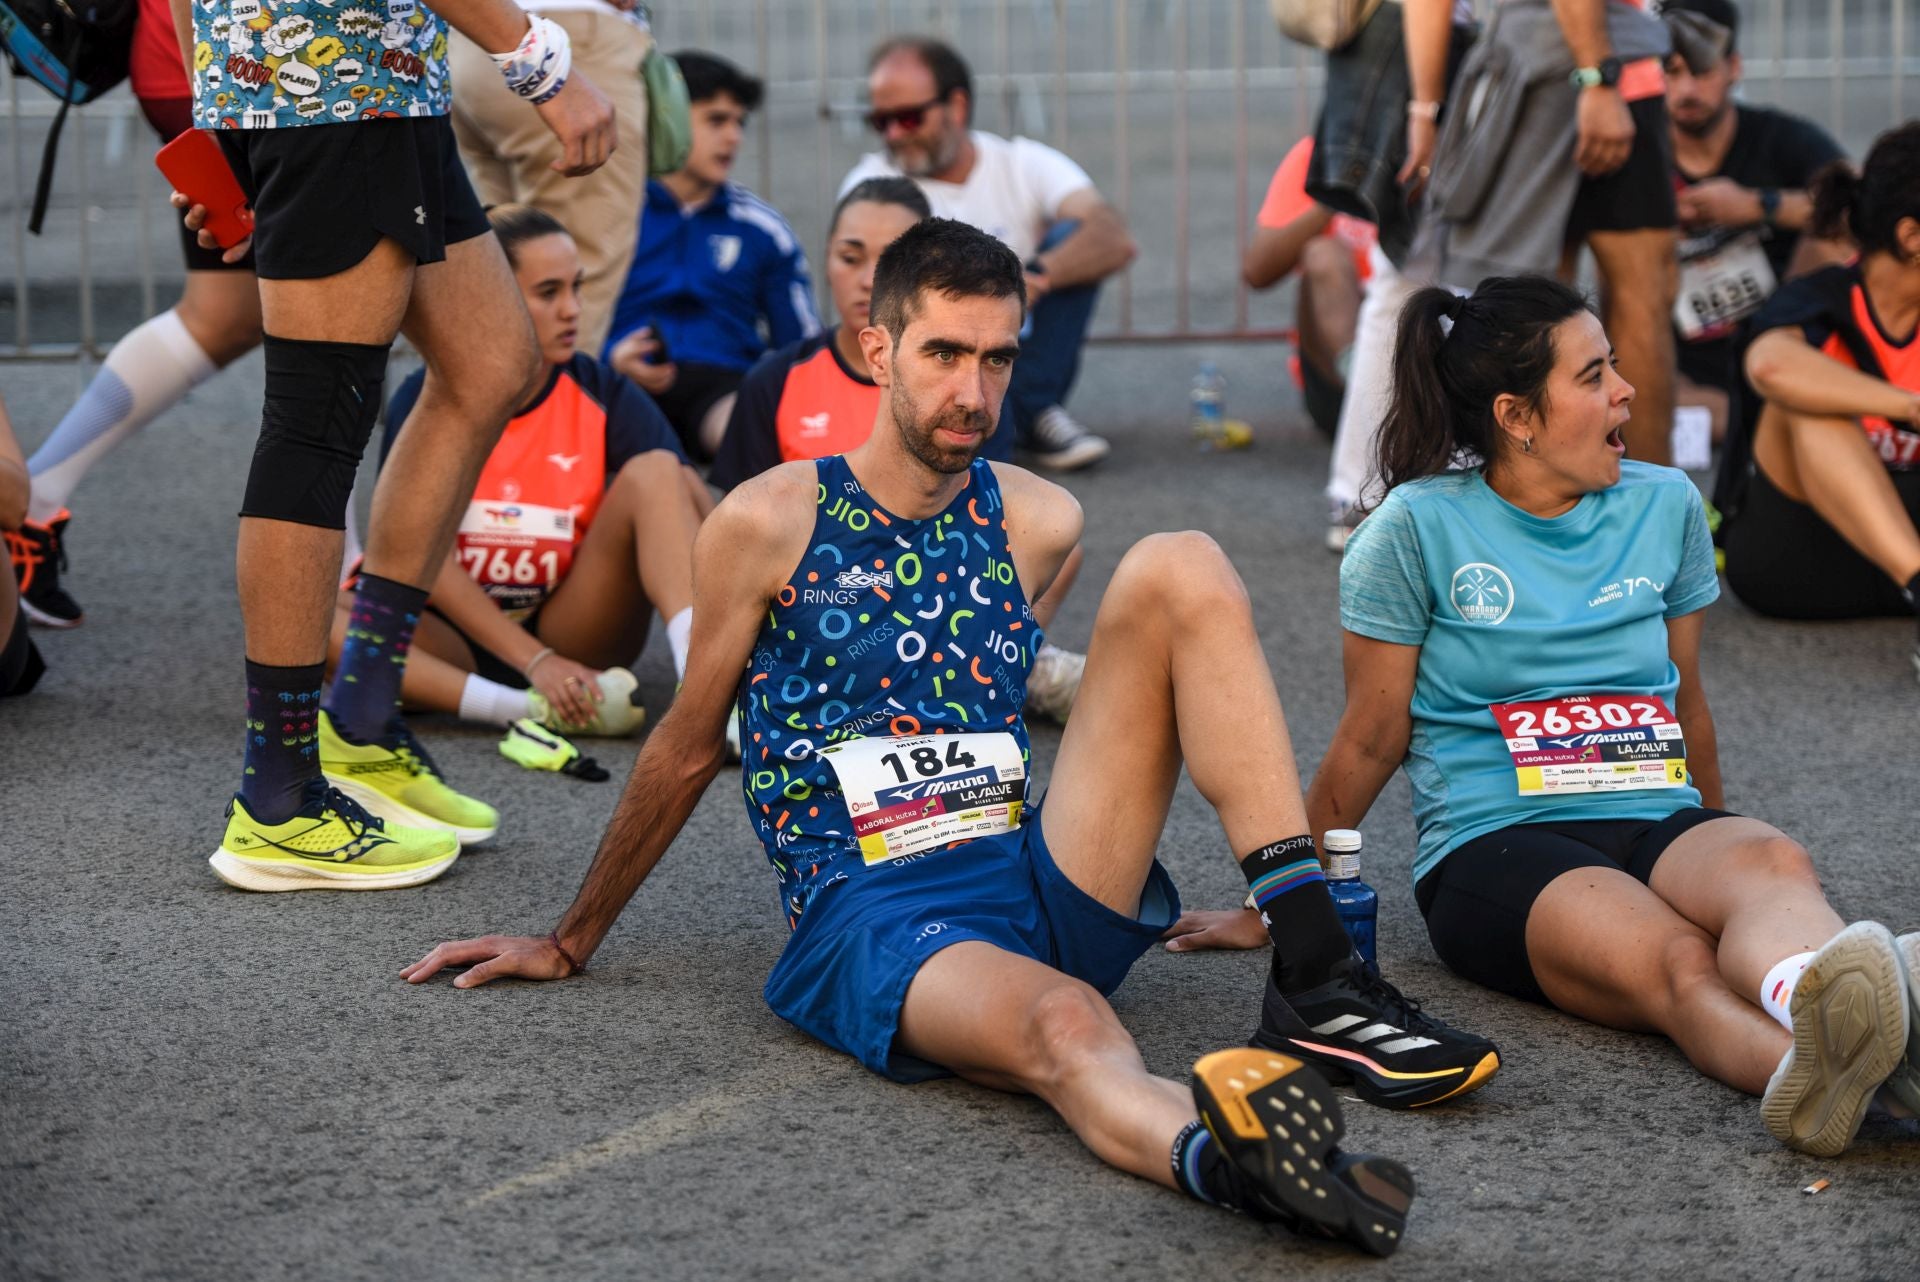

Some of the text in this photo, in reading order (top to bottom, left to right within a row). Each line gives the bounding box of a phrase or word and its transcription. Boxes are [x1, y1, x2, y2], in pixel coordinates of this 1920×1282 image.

[455, 546, 559, 583] 7661
[803, 588, 859, 605] RINGS
[847, 622, 895, 660] RINGS
[1561, 696, 1591, 704] XABI
[1508, 703, 1666, 737] 26302
[895, 739, 936, 749] MIKEL
[1617, 741, 1670, 755] LA SALVE
[880, 740, 977, 784] 184
[1517, 755, 1553, 764] LABORAL
[1674, 766, 1683, 779] 6
[960, 783, 1013, 802] LA SALVE
[858, 815, 895, 832] LABORAL
